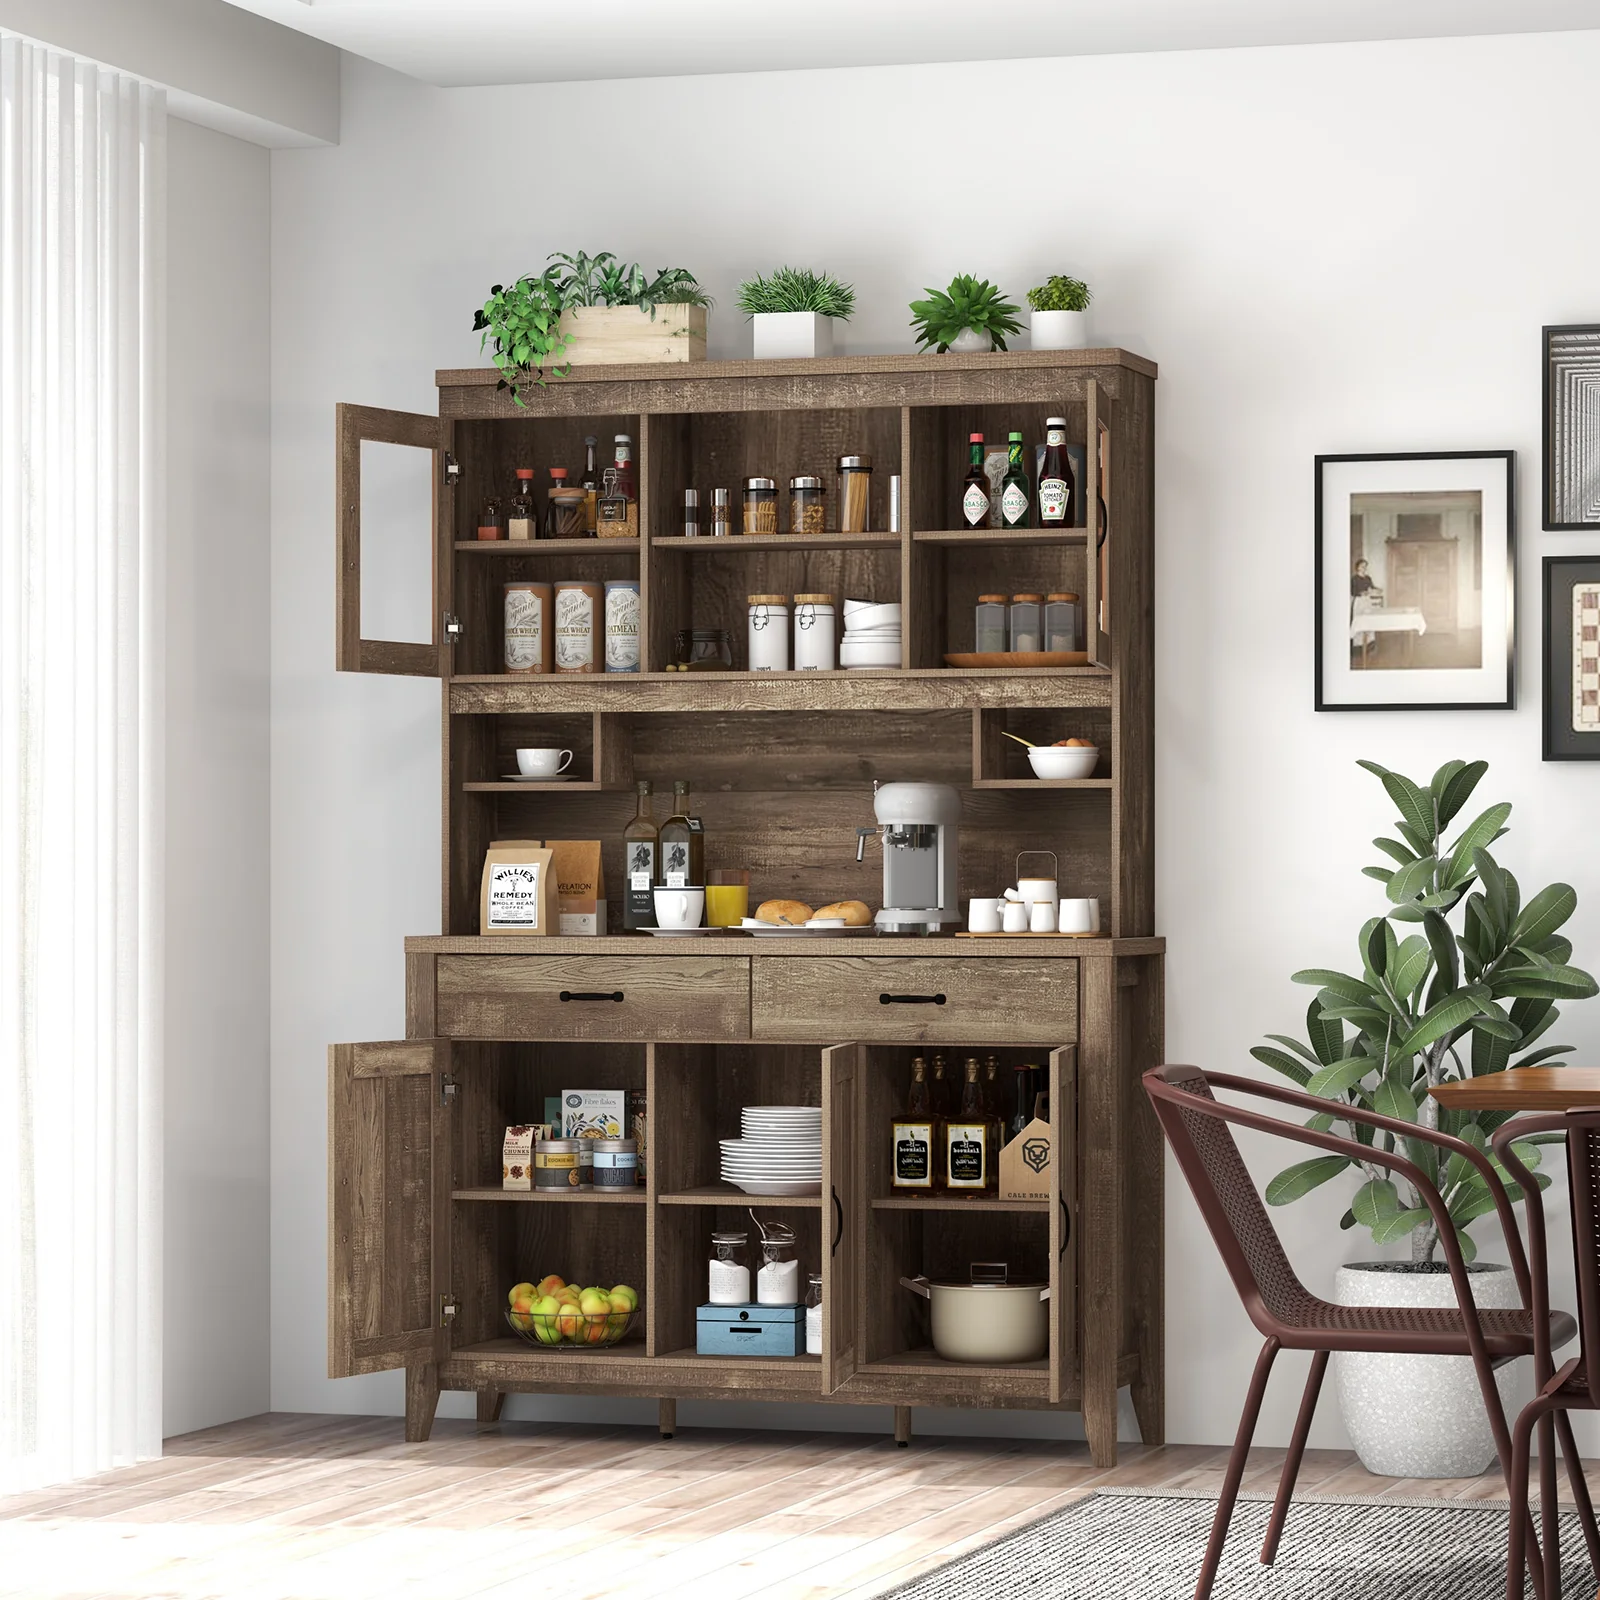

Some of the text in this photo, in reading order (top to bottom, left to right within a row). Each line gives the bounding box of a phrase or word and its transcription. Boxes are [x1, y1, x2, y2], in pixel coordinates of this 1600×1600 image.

[607, 625, 638, 633] OATMEAL
[494, 868, 535, 883] WILLIE'S
[603, 1168, 625, 1183] SUGAR
